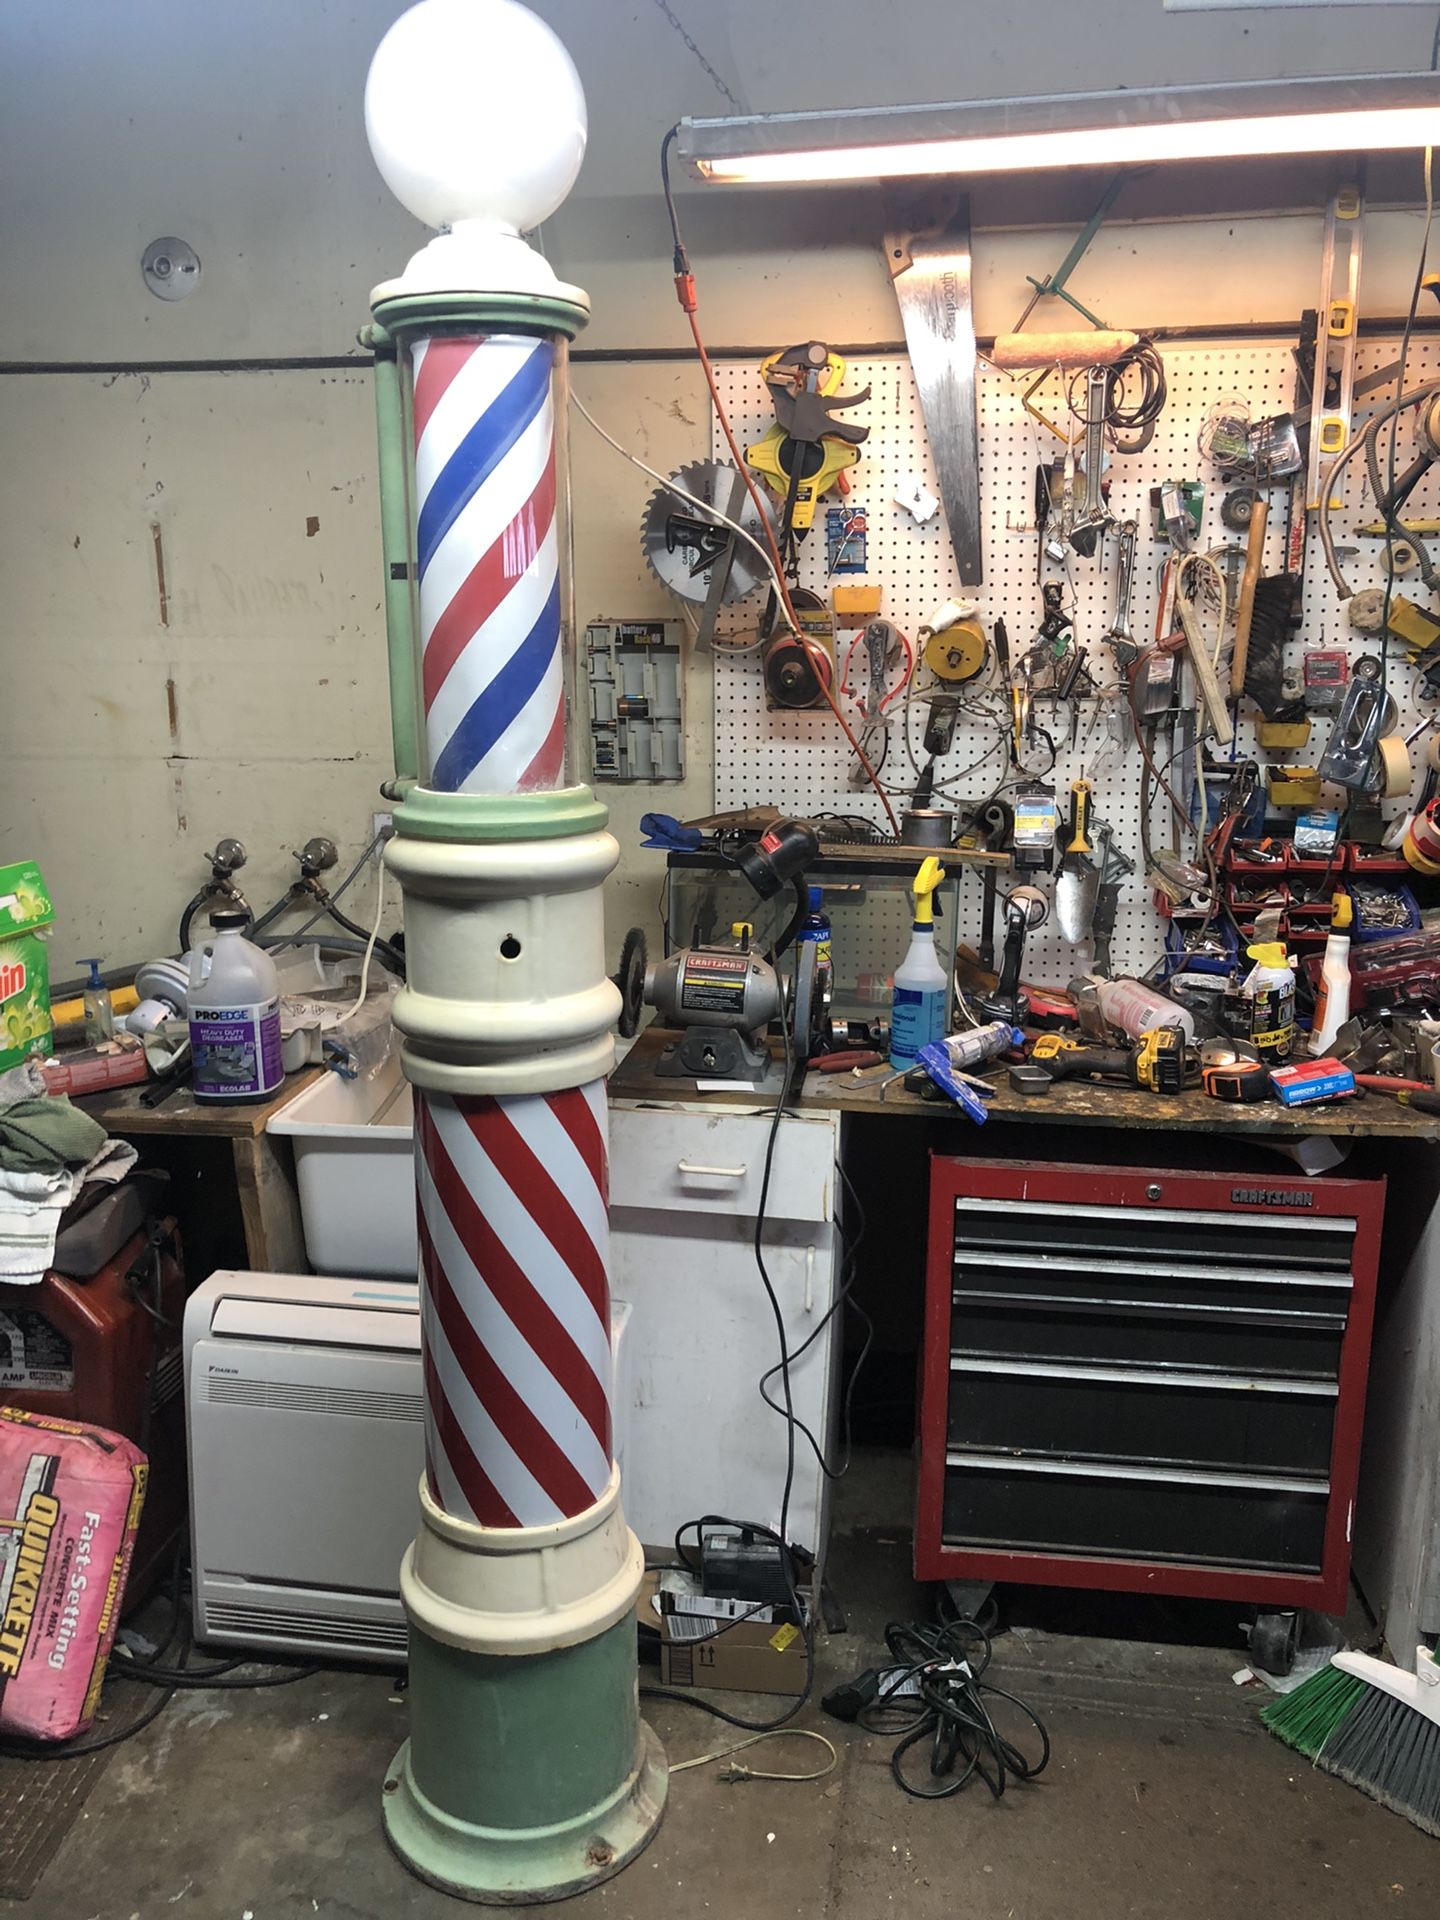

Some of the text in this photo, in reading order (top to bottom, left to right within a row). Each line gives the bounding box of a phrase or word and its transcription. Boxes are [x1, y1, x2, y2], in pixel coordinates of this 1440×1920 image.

[689, 958, 743, 969] CRAFTSMAN
[195, 1010, 248, 1020] PROEDGE
[1231, 1189, 1313, 1206] CRAFTSMAN
[2, 1373, 25, 1381] AMP
[0, 1493, 59, 1679] QUIKRETE
[45, 1537, 74, 1639] CONCRETE MIX
[48, 1511, 101, 1669] Fast-Setting
